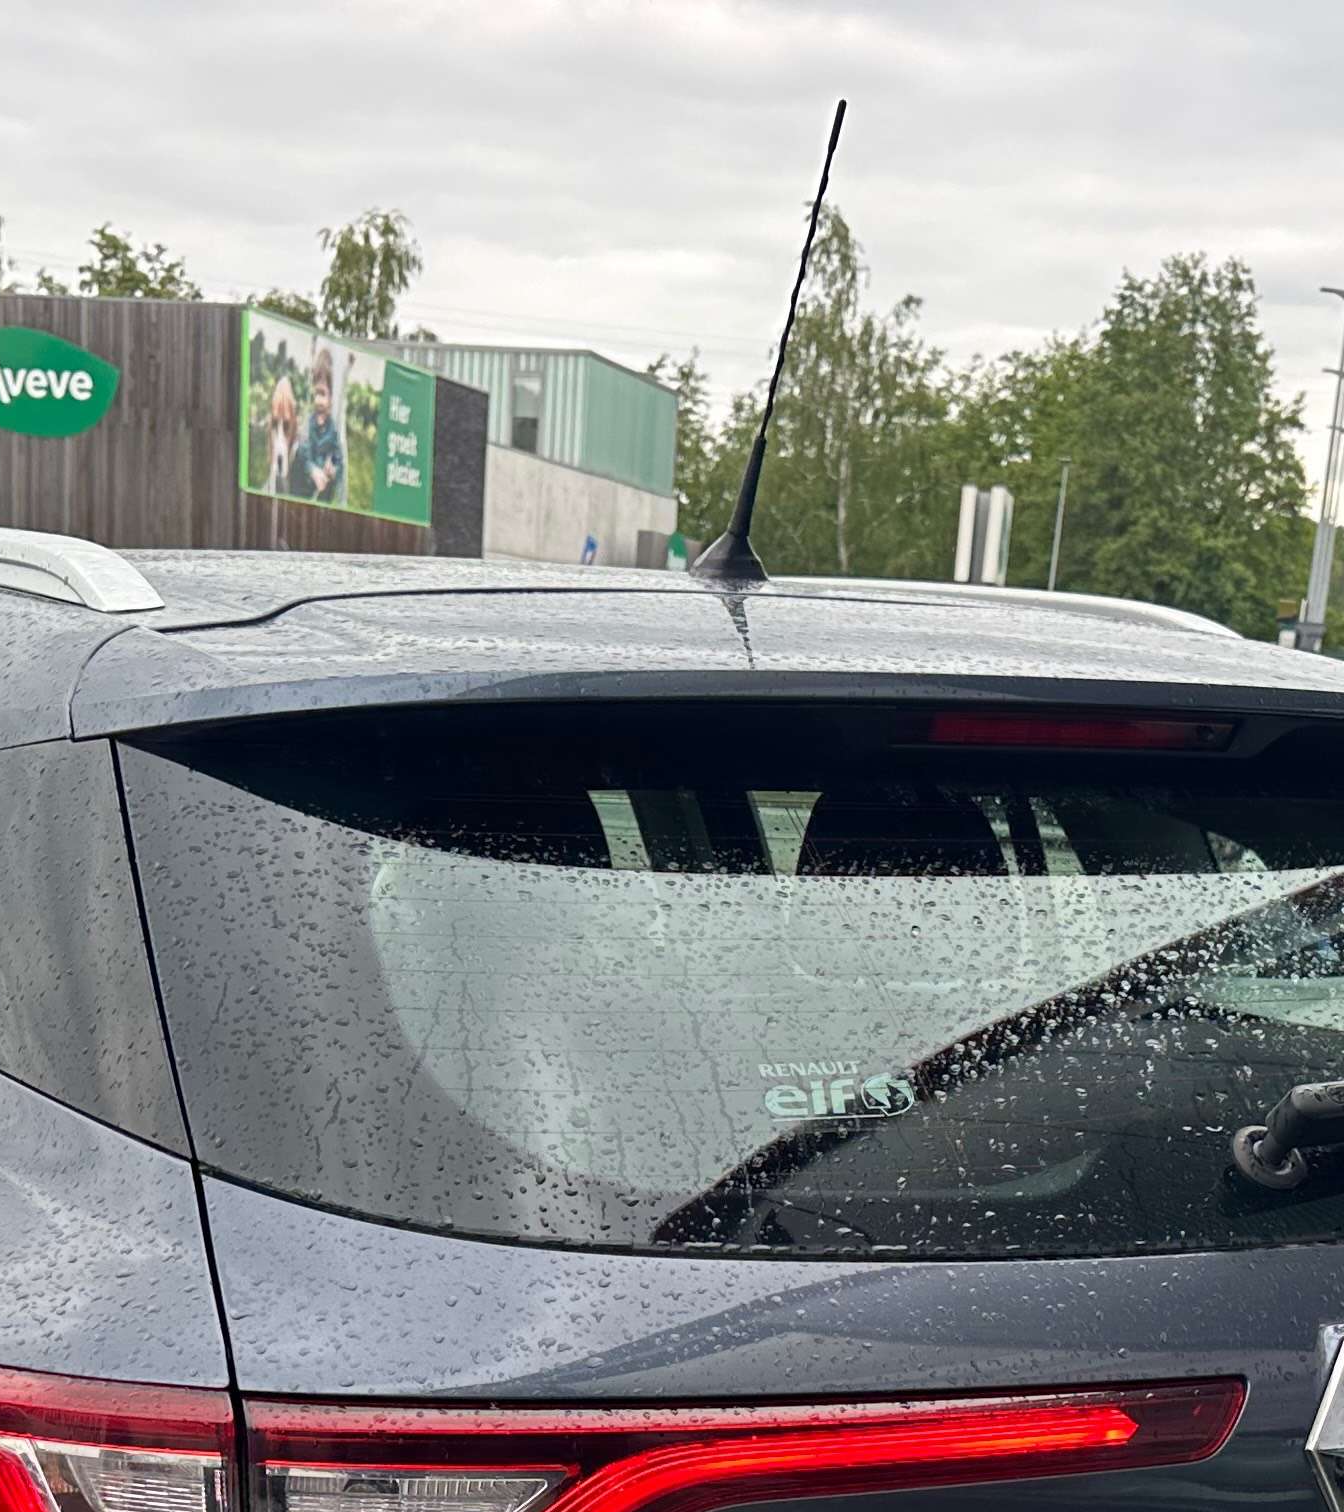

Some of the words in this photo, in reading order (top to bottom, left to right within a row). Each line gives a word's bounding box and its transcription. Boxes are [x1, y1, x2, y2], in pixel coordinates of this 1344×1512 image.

[389, 395, 411, 424] Hier
[759, 1060, 861, 1078] RENAULT
[765, 1078, 856, 1116] elf
